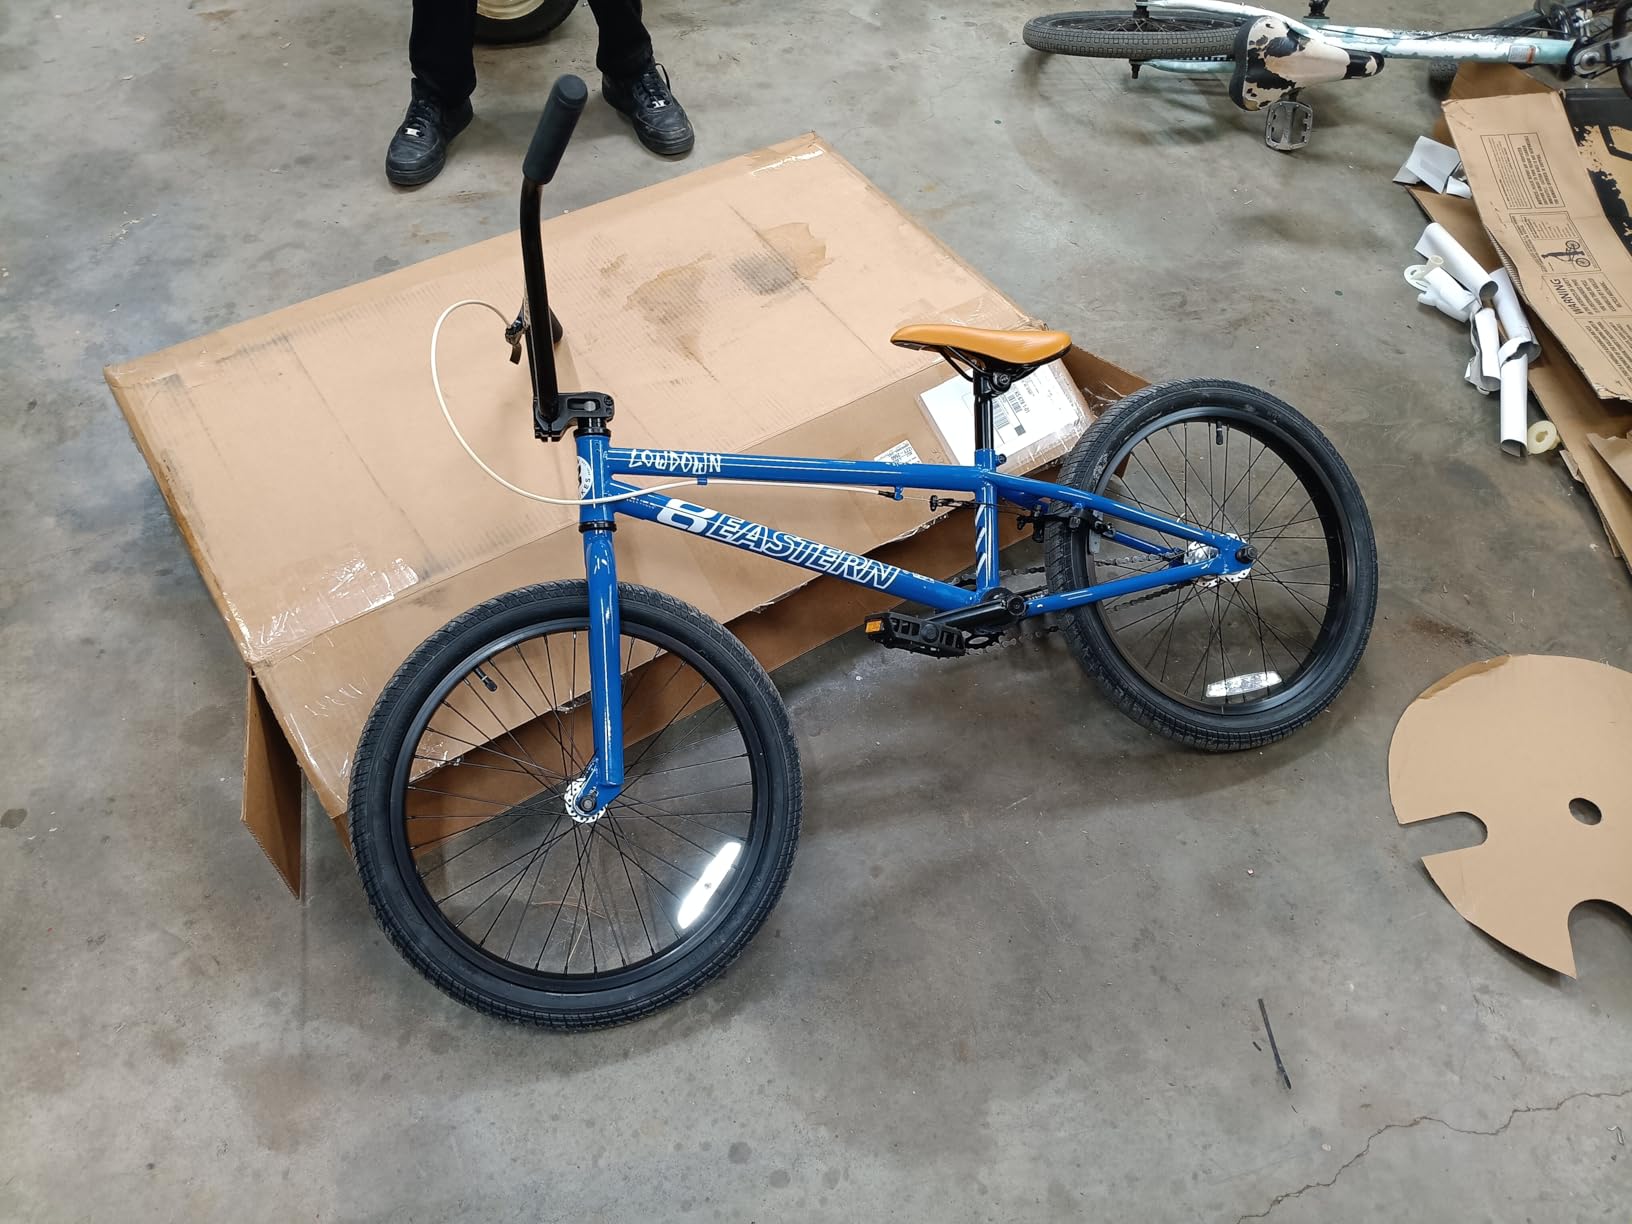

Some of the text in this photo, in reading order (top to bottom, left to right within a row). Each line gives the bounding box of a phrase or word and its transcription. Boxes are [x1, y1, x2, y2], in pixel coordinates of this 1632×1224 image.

[1549, 278, 1585, 314] WARNING
[629, 448, 721, 475] LOWDOWN
[707, 513, 900, 590] EASTERN
